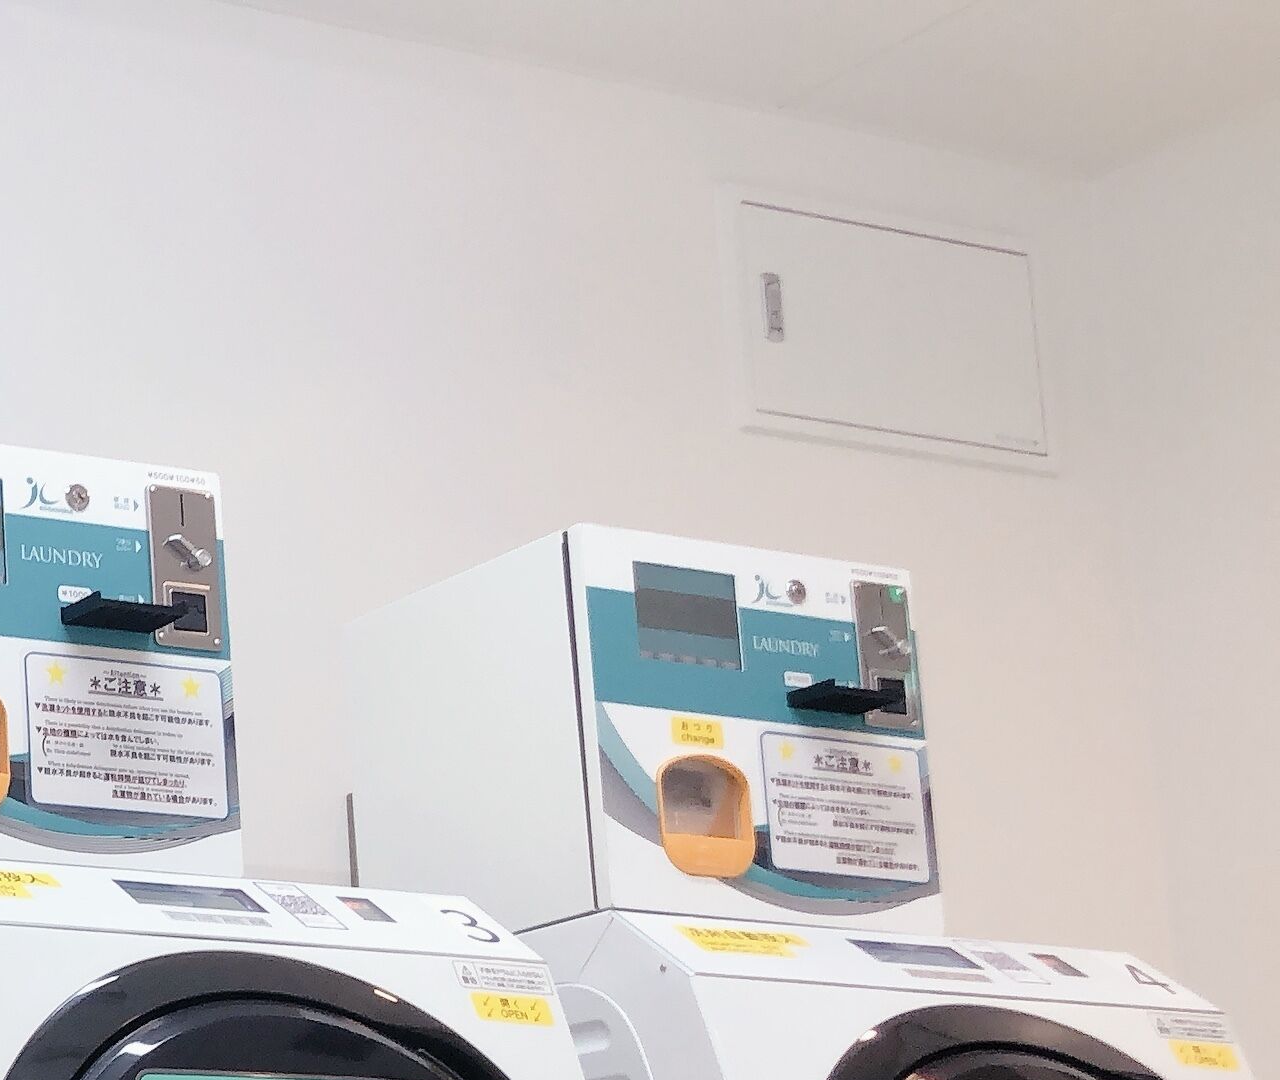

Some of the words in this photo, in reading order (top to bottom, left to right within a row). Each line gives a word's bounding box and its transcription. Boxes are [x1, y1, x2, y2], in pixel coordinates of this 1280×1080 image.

[21, 544, 103, 569] LAUNDRY
[753, 635, 819, 657] LAUNDRY
[440, 909, 500, 943] 3
[1124, 963, 1177, 995] 4
